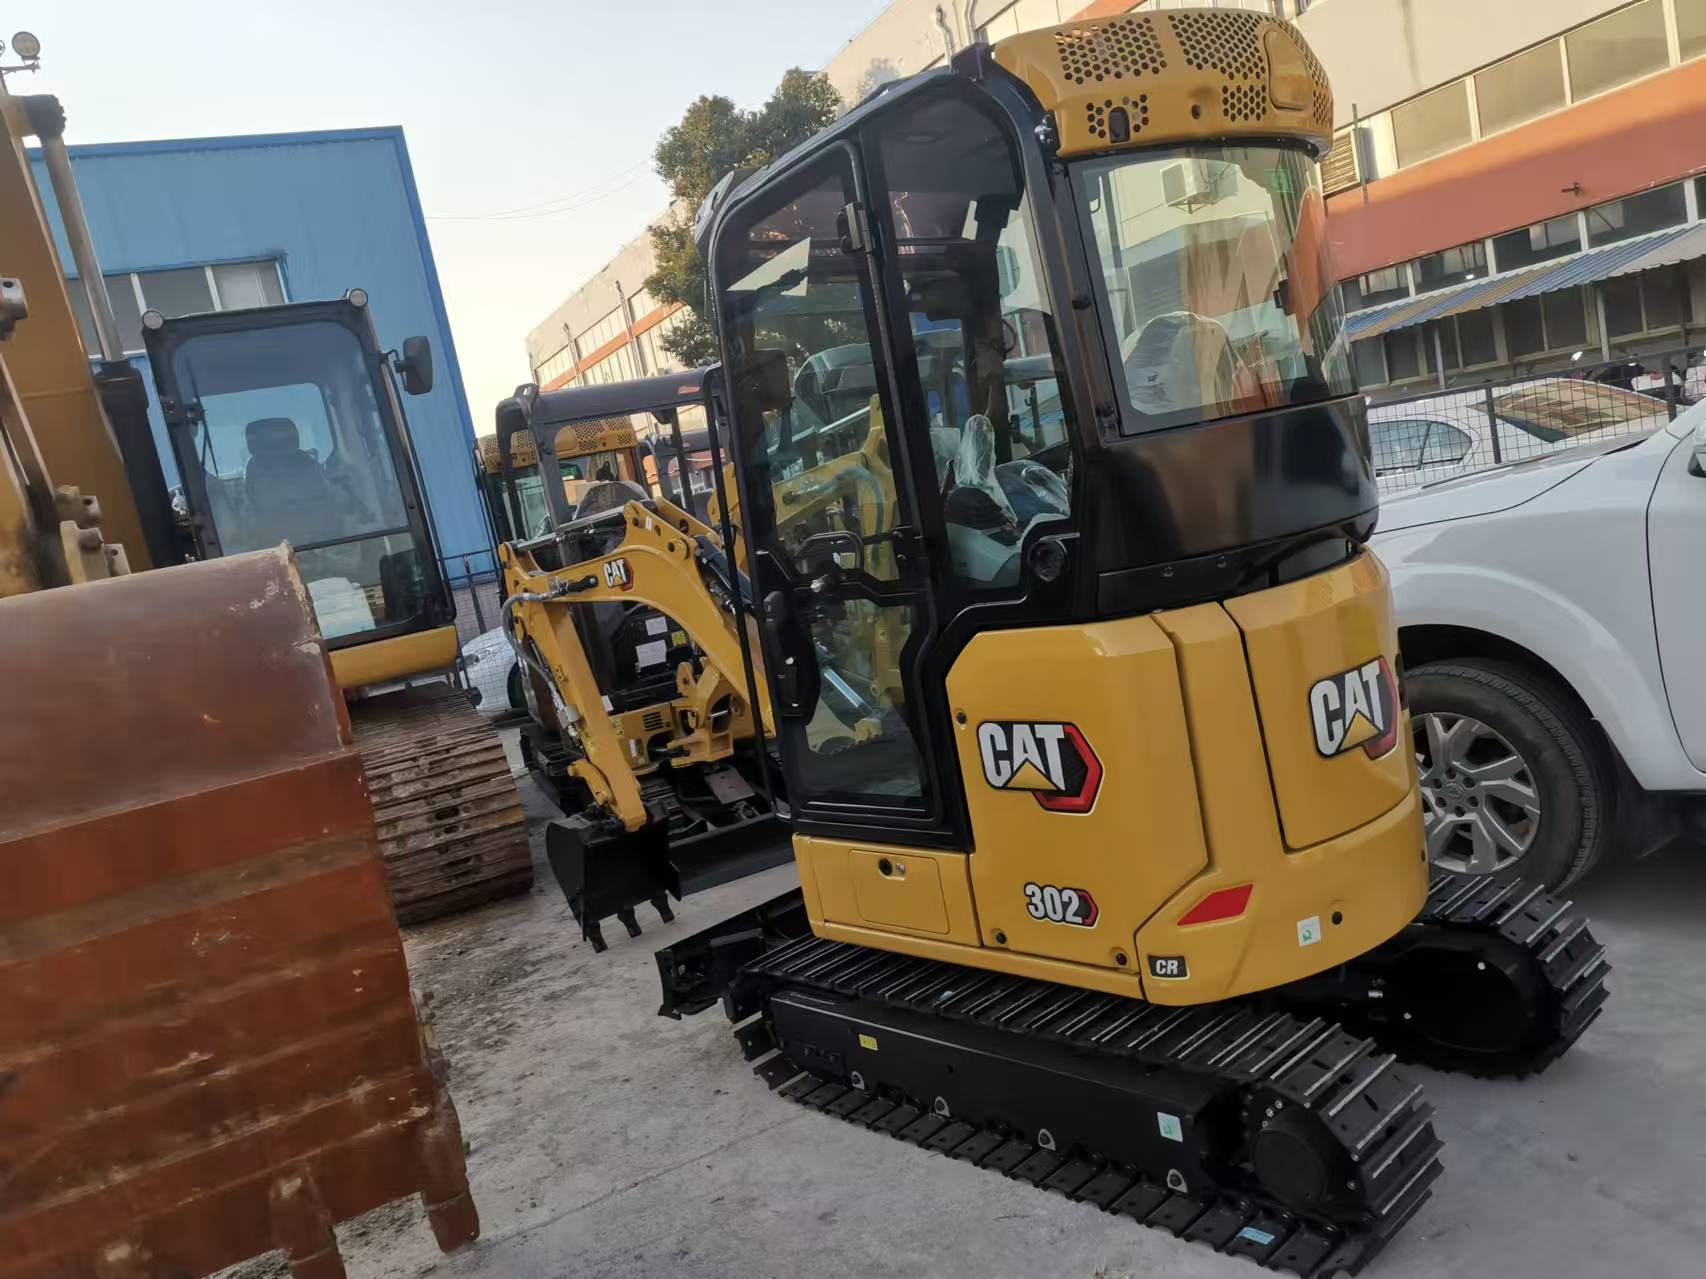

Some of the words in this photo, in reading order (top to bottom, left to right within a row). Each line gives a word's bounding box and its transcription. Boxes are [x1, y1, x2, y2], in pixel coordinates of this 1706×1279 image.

[603, 558, 627, 588] CAT
[1310, 659, 1384, 755] CAT
[978, 722, 1066, 791] CAT
[1025, 883, 1083, 924] 302
[1155, 959, 1179, 975] CR
